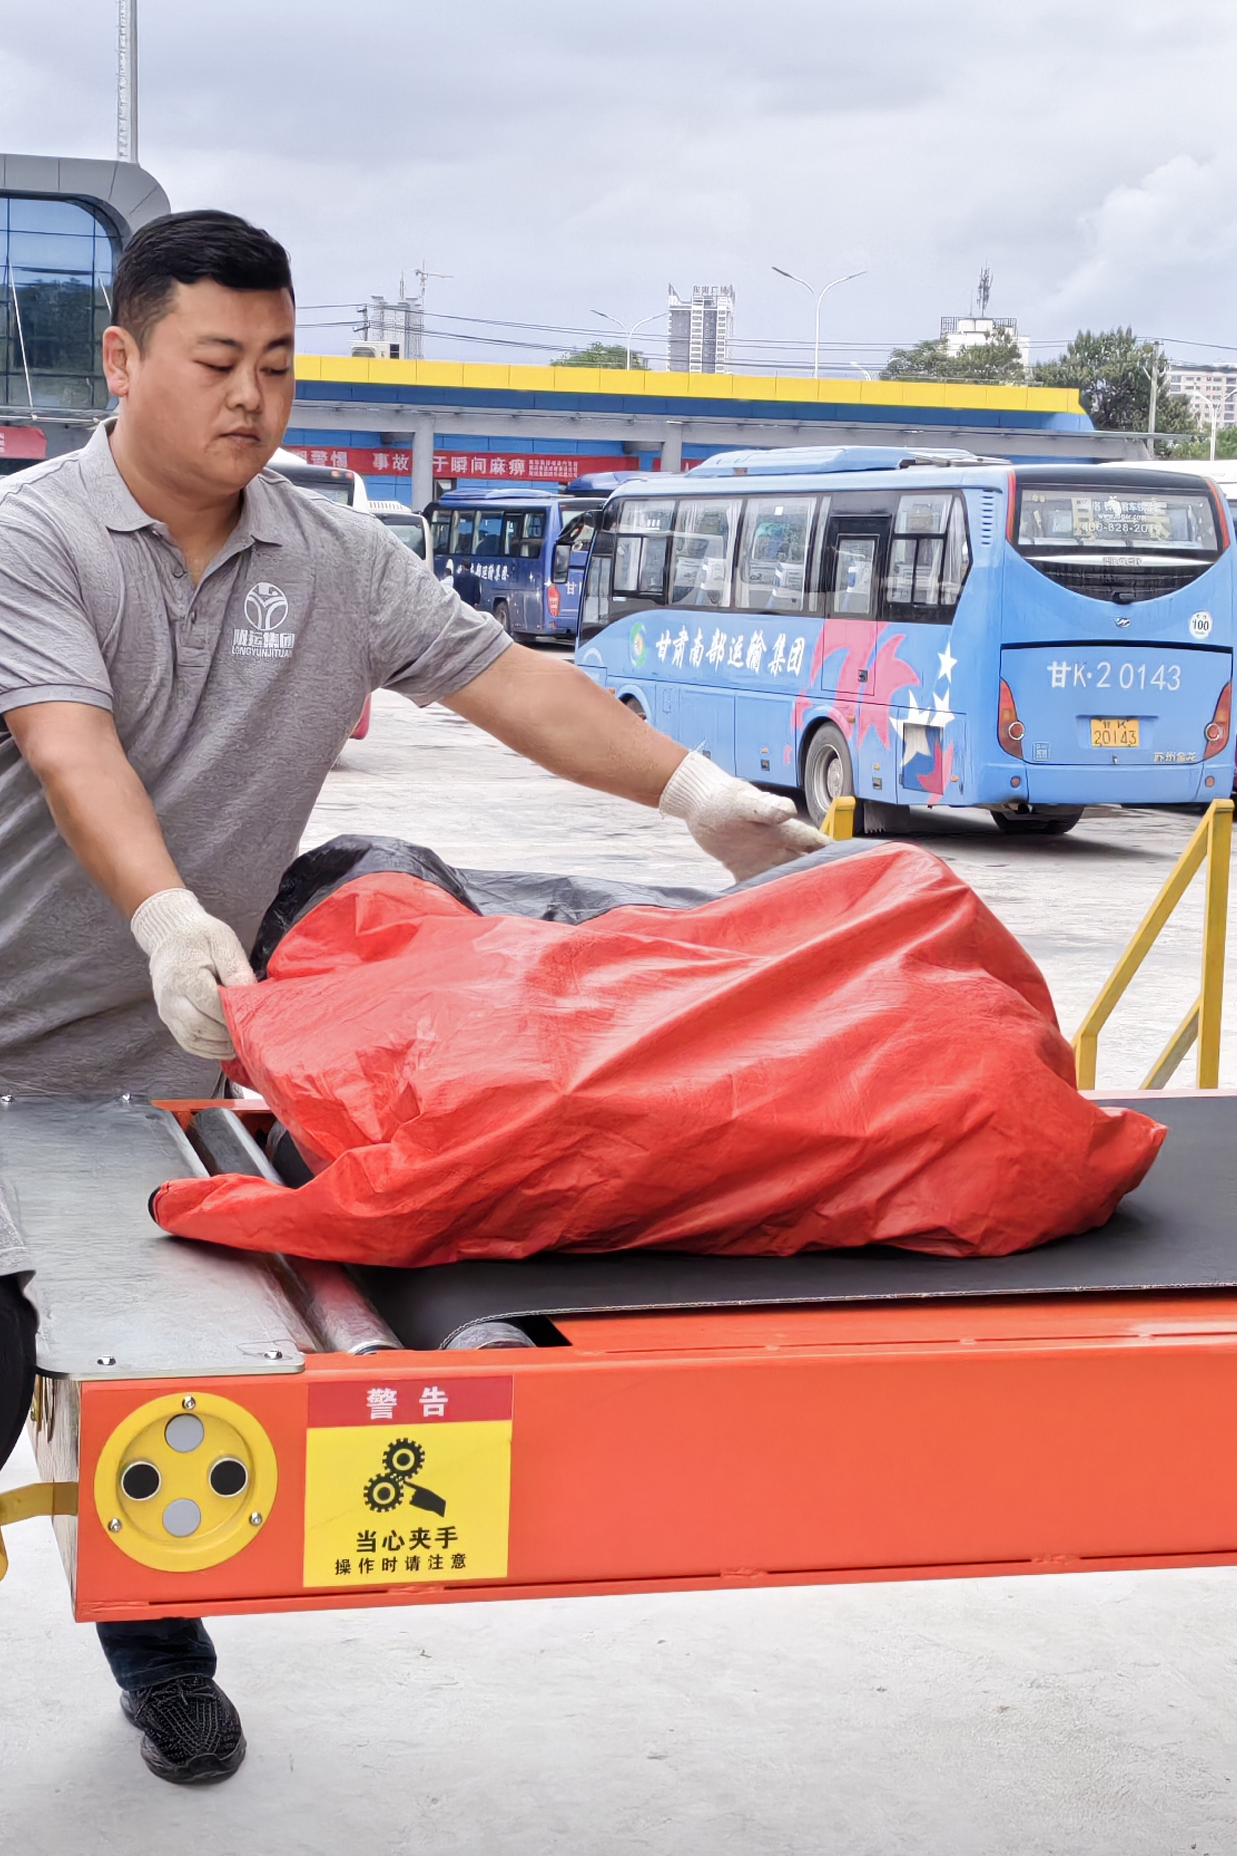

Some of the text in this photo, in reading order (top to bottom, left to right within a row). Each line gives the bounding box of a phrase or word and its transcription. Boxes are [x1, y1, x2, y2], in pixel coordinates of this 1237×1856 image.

[1192, 618, 1210, 631] 100
[655, 624, 806, 678] 甘肃南部运输集团
[1094, 730, 1137, 745] 20143
[366, 1386, 449, 1420] 警告
[356, 1526, 458, 1553] 当心夹手
[334, 1553, 467, 1576] 操作时请注意
